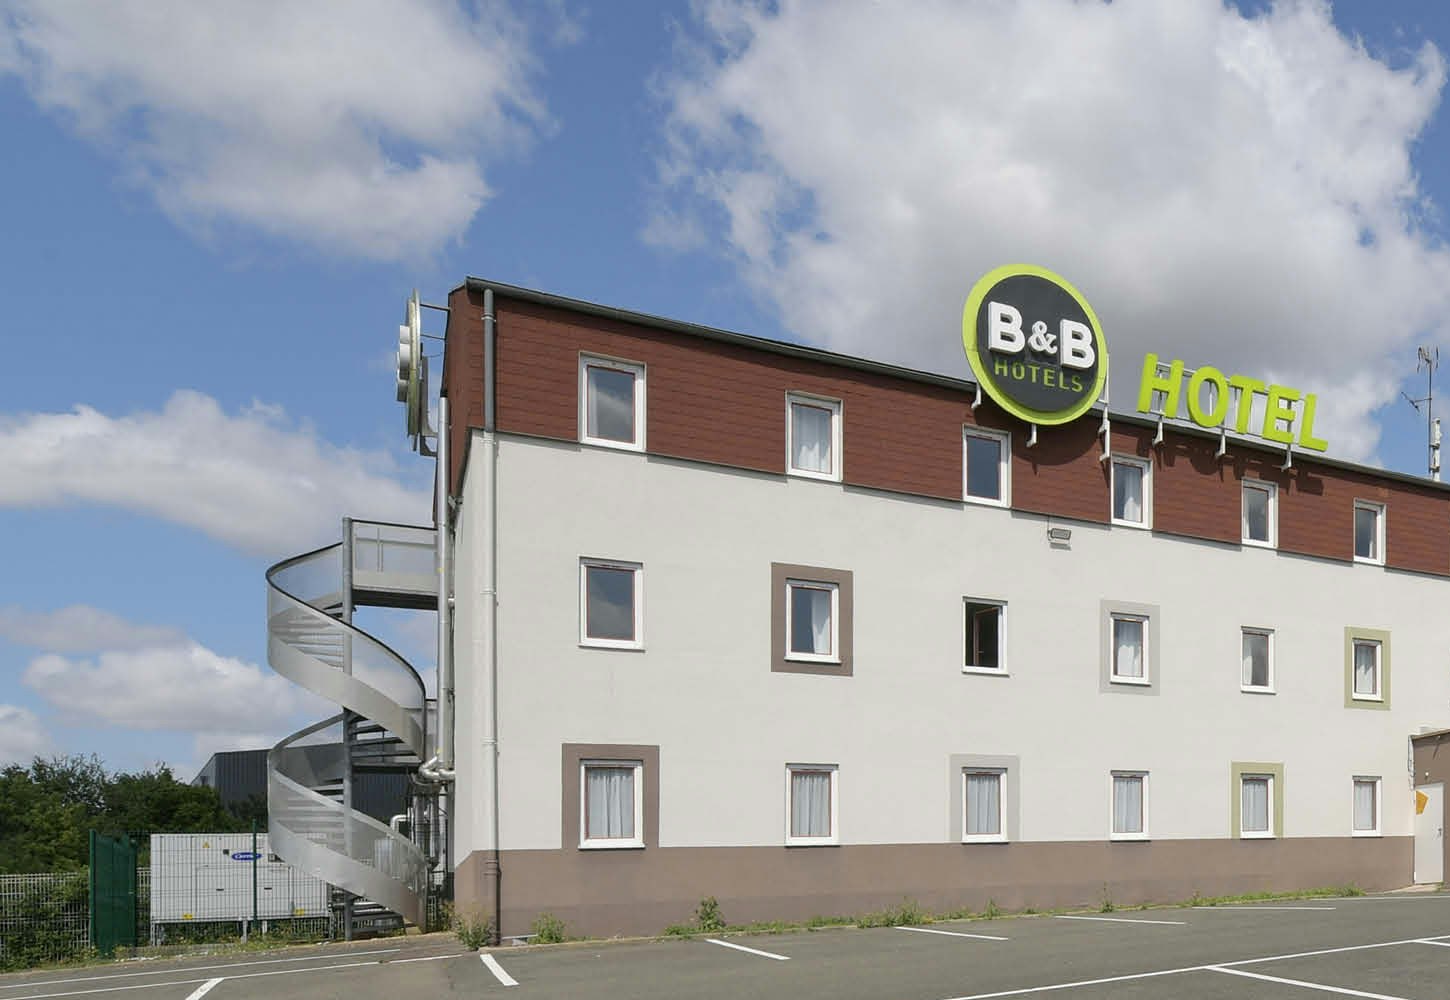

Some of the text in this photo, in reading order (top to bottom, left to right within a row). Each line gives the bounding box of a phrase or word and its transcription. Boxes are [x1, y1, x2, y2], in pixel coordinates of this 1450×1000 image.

[988, 301, 1095, 369] B&B
[994, 360, 1083, 393] HOTELS
[1138, 353, 1328, 451] HOTEL
